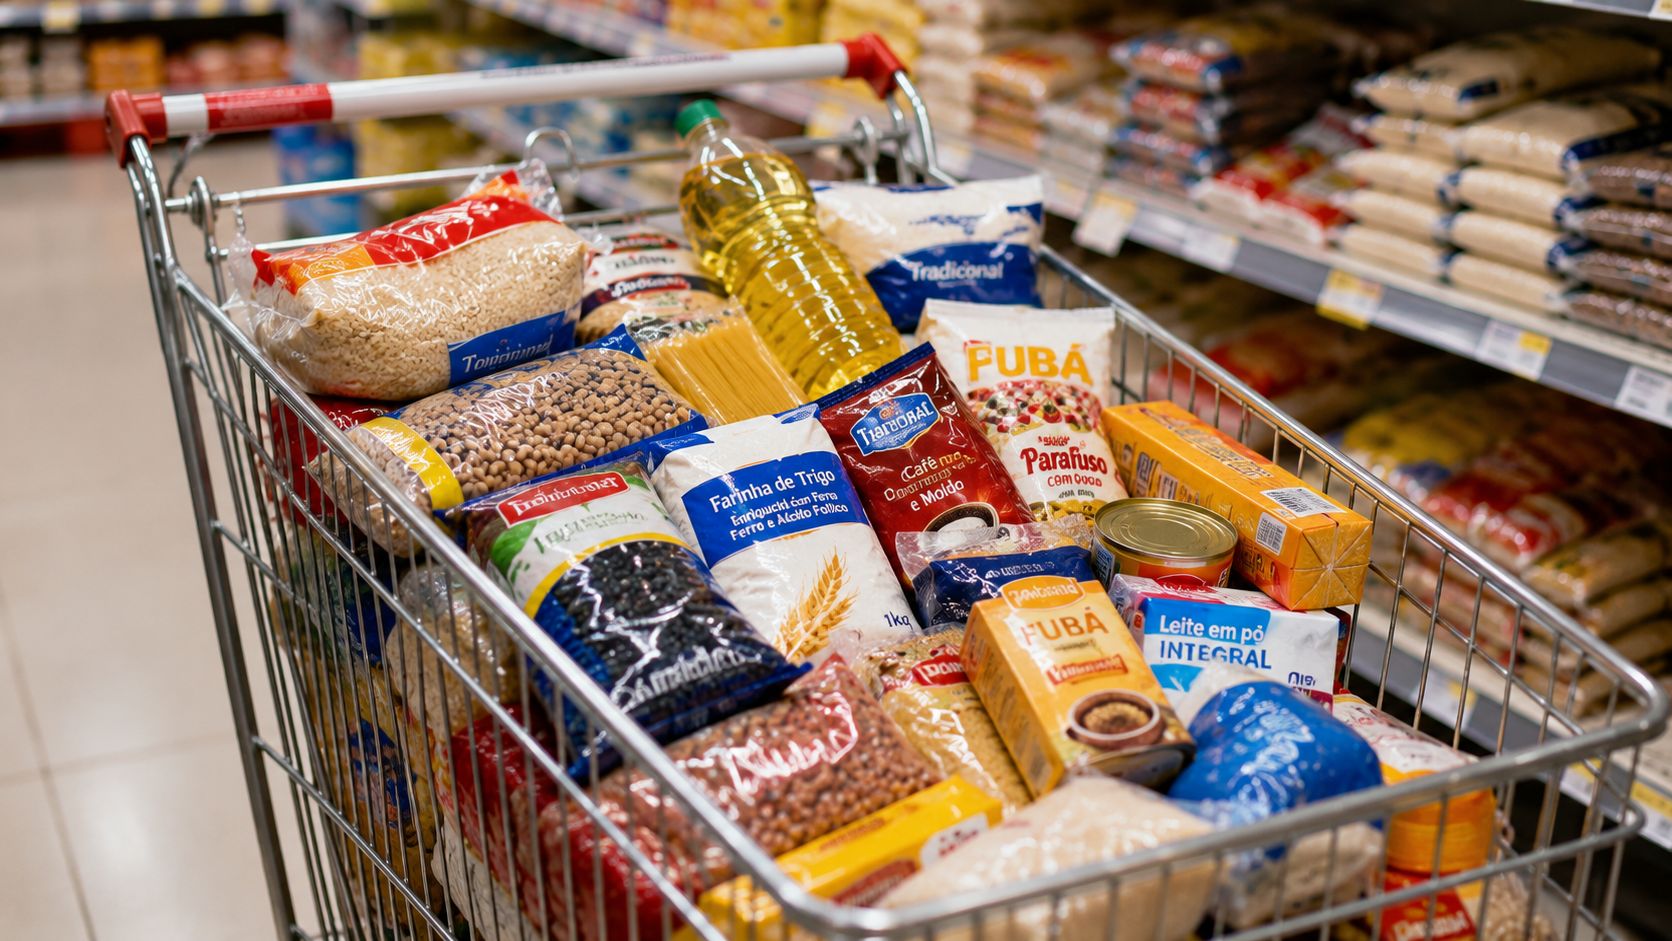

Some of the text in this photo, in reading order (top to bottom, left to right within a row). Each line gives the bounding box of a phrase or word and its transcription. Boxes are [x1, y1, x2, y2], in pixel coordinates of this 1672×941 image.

[1019, 446, 1108, 476] Parafuso
[709, 468, 836, 513] Farinha de Trigo
[910, 500, 921, 511] e
[729, 521, 765, 541] Ferro
[766, 519, 776, 529] e
[1159, 615, 1205, 636] Leite
[1208, 625, 1237, 641] em
[1160, 640, 1272, 670] INTEGRAL
